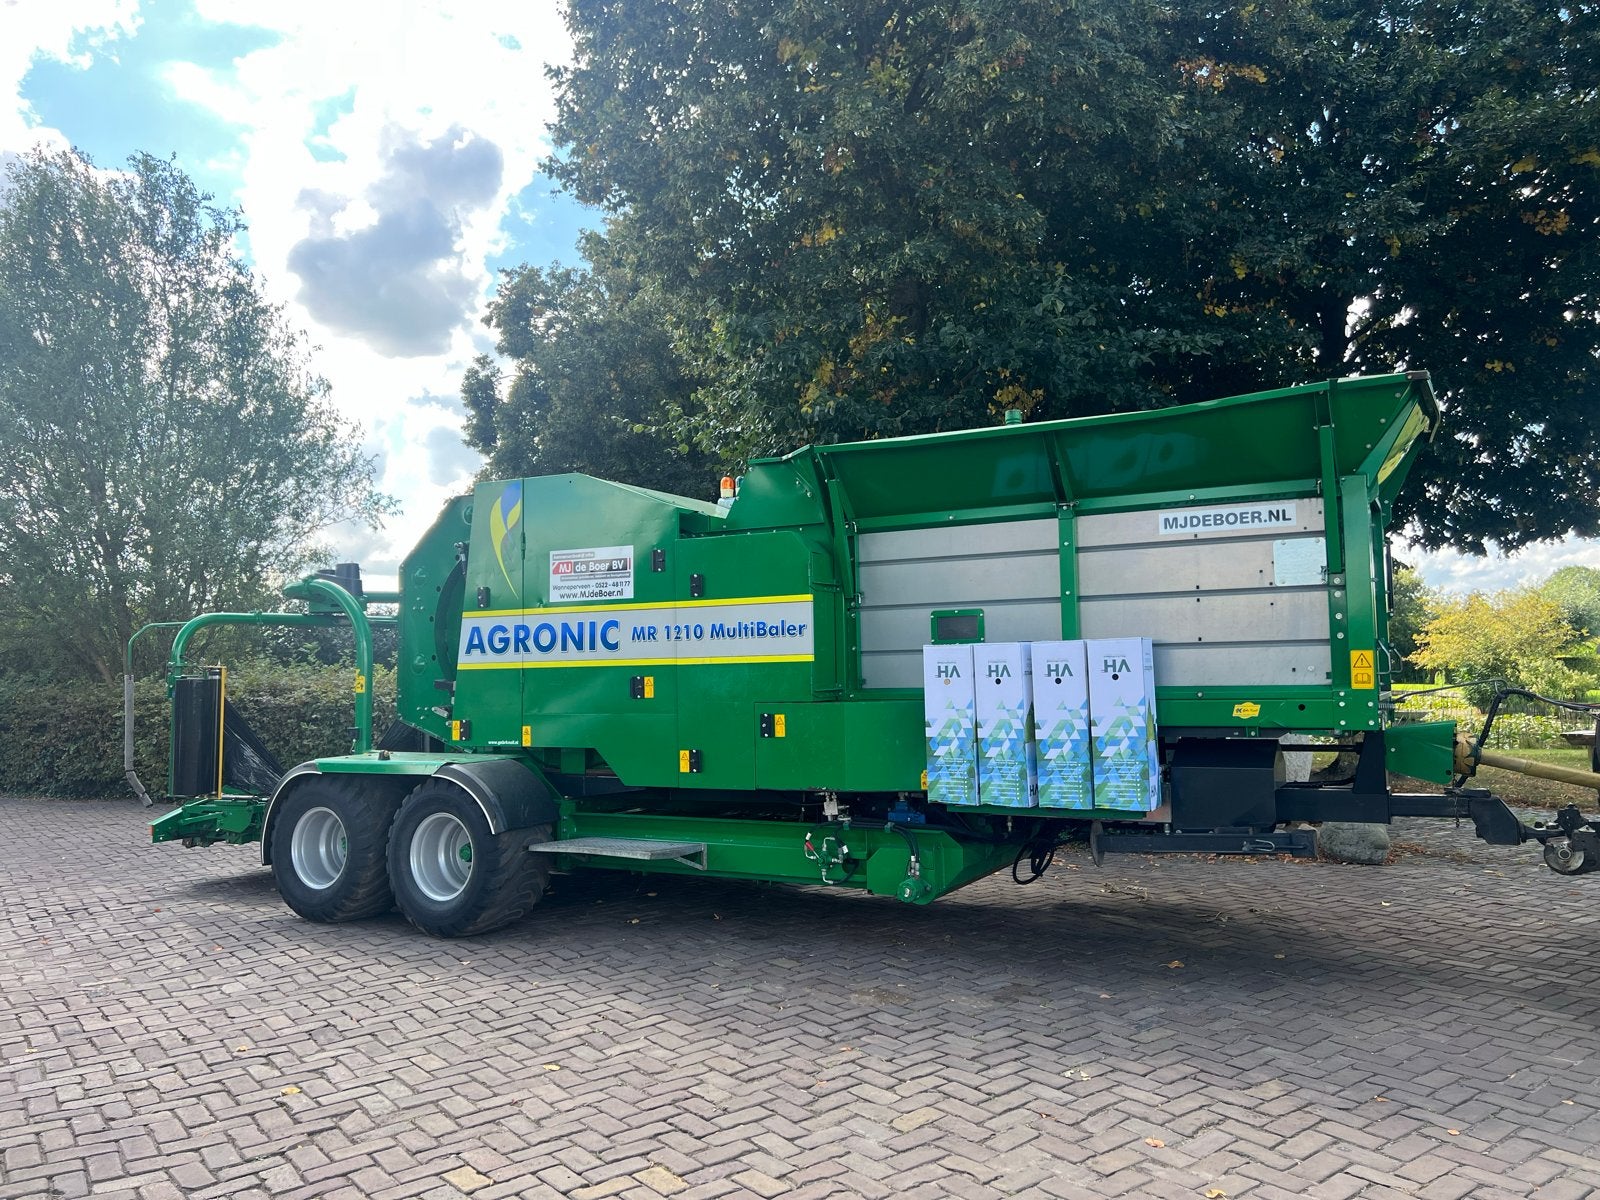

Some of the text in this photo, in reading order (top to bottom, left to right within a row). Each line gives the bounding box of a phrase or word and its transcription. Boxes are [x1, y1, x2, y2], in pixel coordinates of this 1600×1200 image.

[1163, 509, 1292, 530] MJDEBOER.NL
[559, 560, 624, 573] MJ de Boer BV
[559, 588, 624, 599] www.MJdeBoer.nl
[464, 619, 807, 656] AGRONIC MR 1210 MultiBaler
